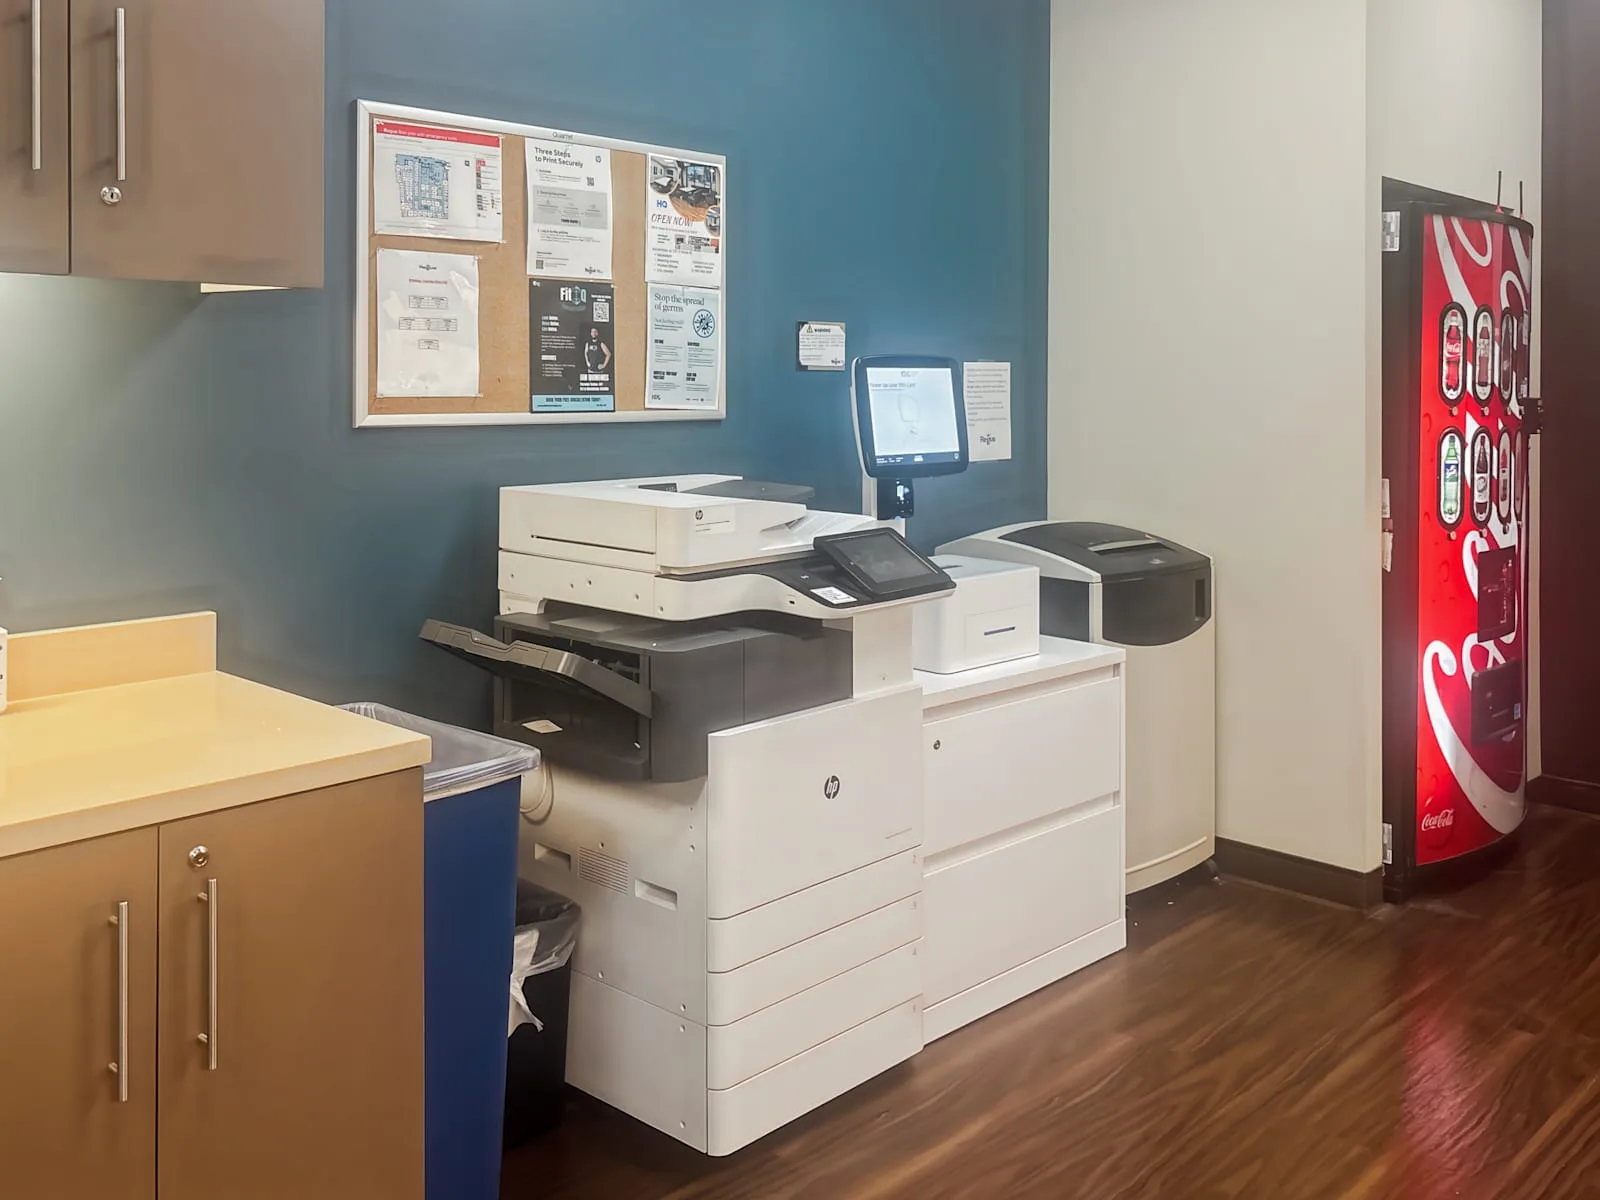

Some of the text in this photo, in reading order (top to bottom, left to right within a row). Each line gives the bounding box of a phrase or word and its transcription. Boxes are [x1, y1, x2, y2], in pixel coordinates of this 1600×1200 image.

[535, 147, 571, 158] Three Steps
[558, 158, 583, 168] Securely
[651, 213, 672, 225] OPEN
[654, 292, 705, 306] Stop the spread
[654, 301, 684, 313] of germs
[824, 775, 840, 800] hp
[1421, 808, 1455, 832] Coca-Cola
